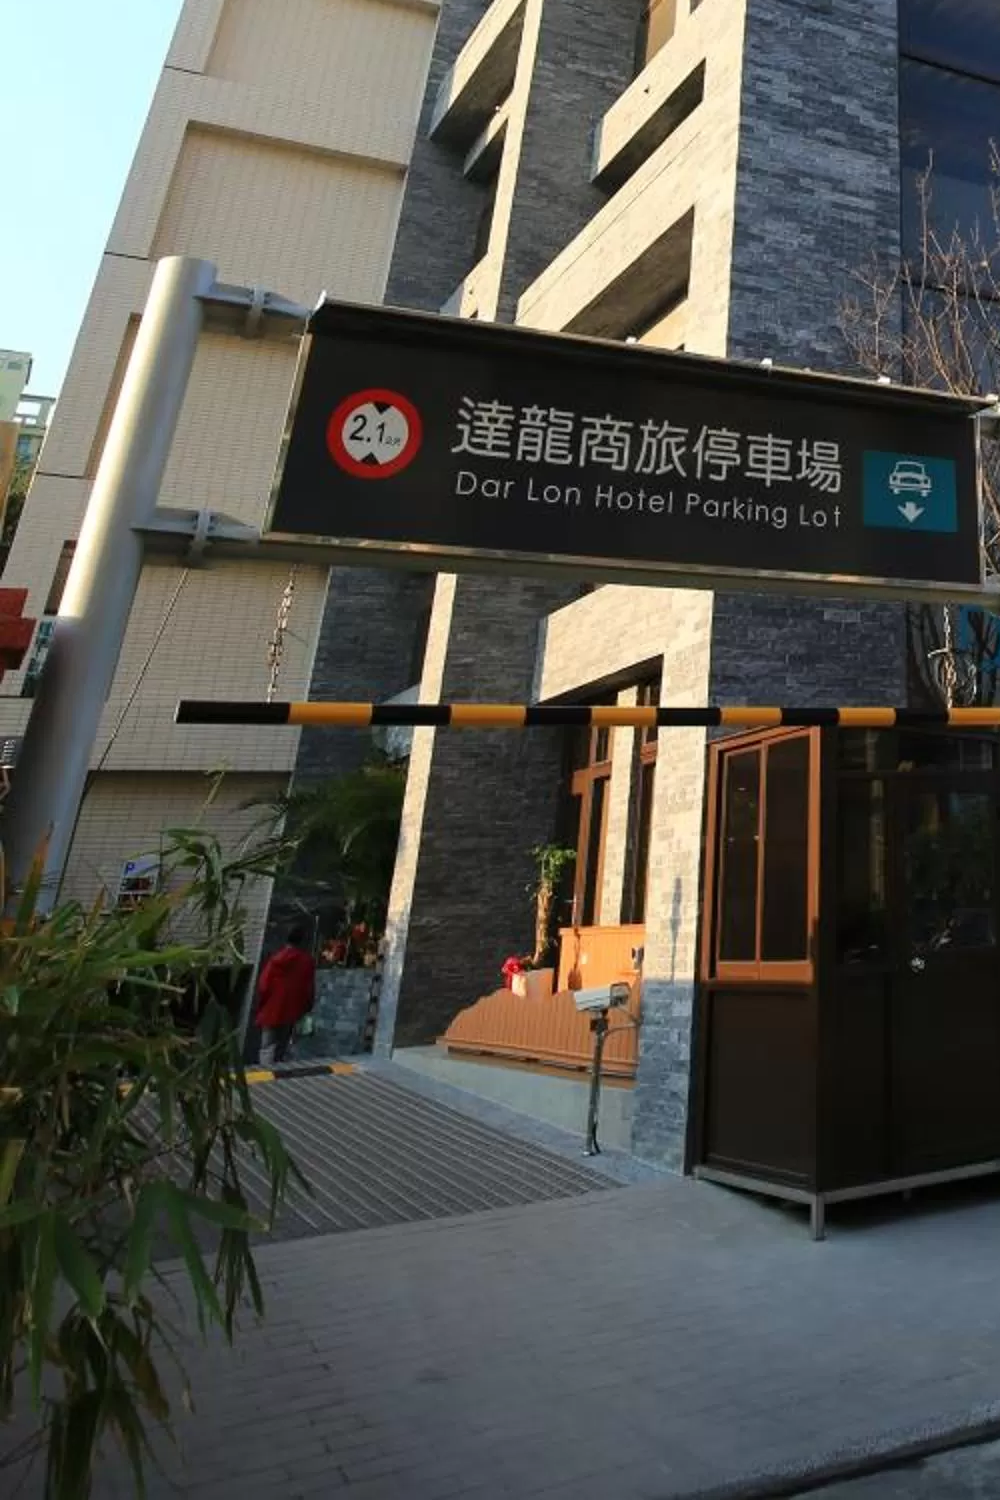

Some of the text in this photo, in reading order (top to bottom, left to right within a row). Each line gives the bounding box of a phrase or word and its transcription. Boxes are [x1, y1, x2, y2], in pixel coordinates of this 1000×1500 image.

[349, 413, 386, 444] 2.1
[450, 396, 842, 493] 達龍商旅停車場
[455, 470, 842, 530] Dar Lon Hotel Parking Lot
